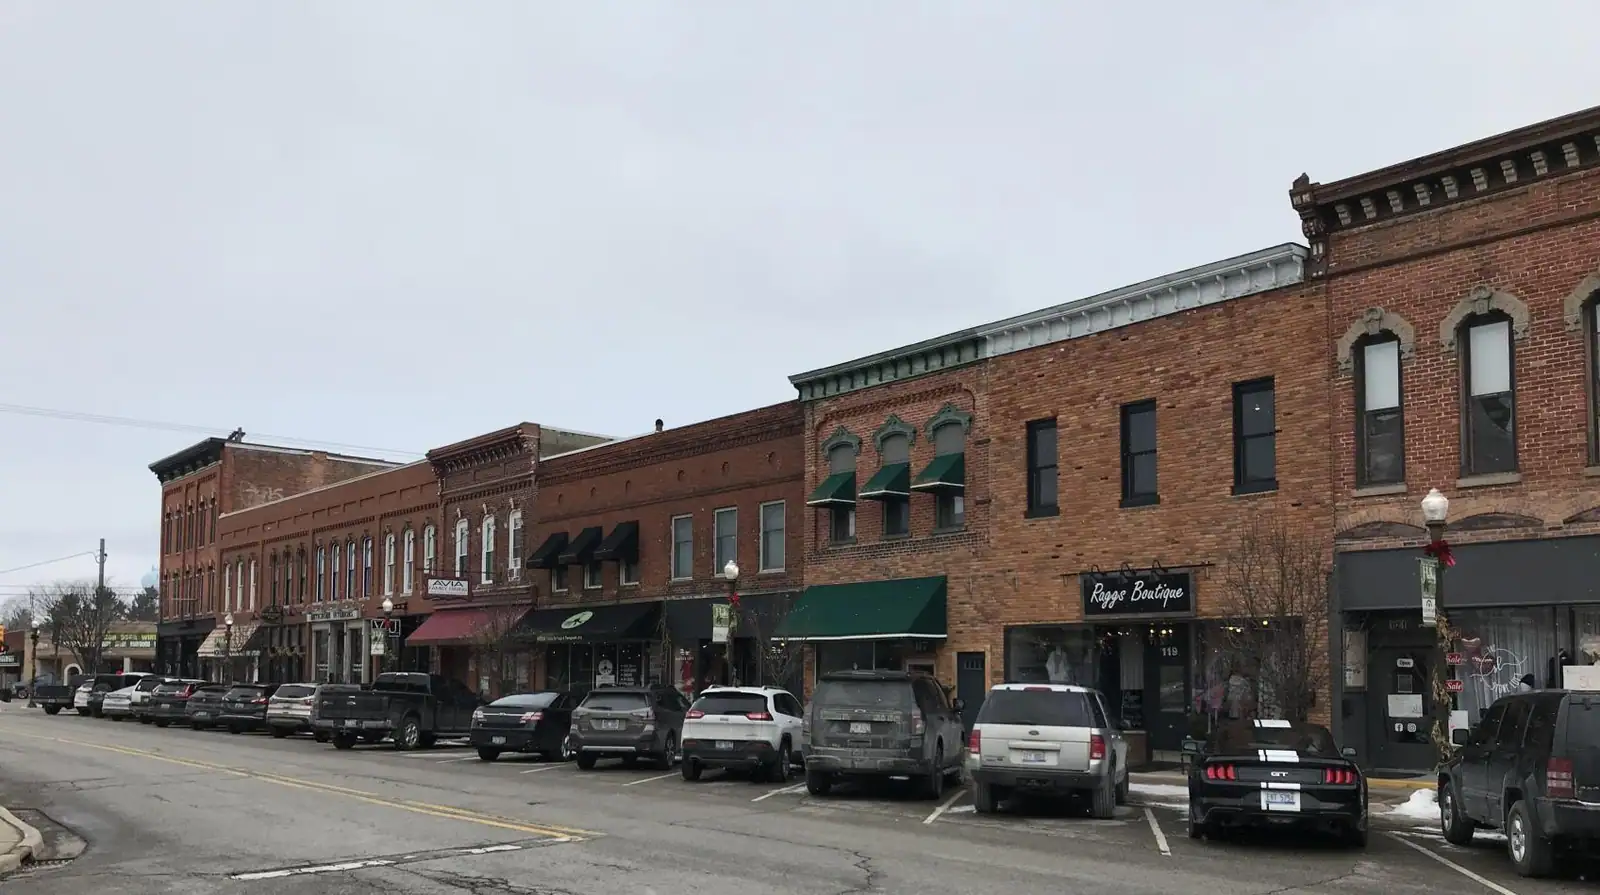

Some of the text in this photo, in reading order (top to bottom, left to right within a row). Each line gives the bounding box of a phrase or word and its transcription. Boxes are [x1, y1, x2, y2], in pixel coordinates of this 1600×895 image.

[1090, 580, 1183, 609] Raggs Boutique
[1161, 647, 1178, 656] 119
[1447, 681, 1463, 690] Sale
